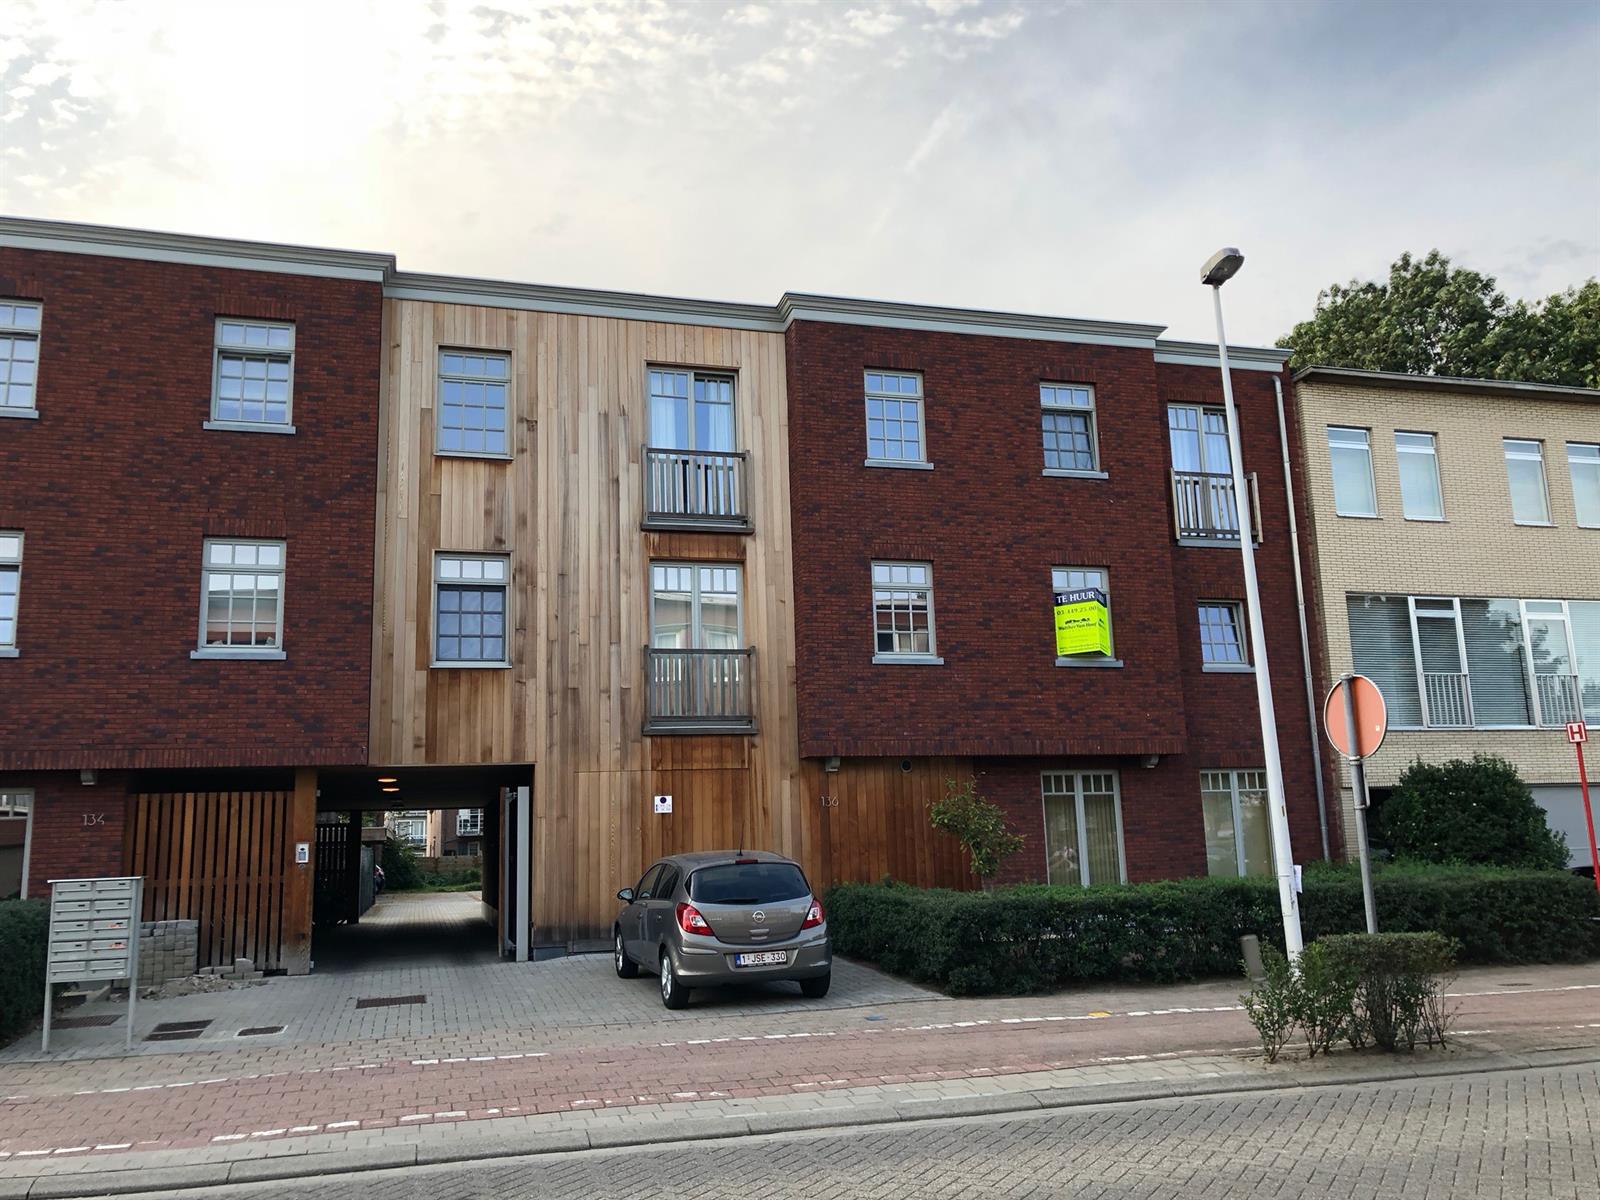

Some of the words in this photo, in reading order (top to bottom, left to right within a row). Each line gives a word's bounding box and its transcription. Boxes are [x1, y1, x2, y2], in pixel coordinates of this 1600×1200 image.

[1056, 595, 1068, 603] TE
[1070, 591, 1095, 601] HUUR
[1569, 725, 1584, 740] H
[820, 796, 839, 807] 136
[82, 813, 105, 826] 134
